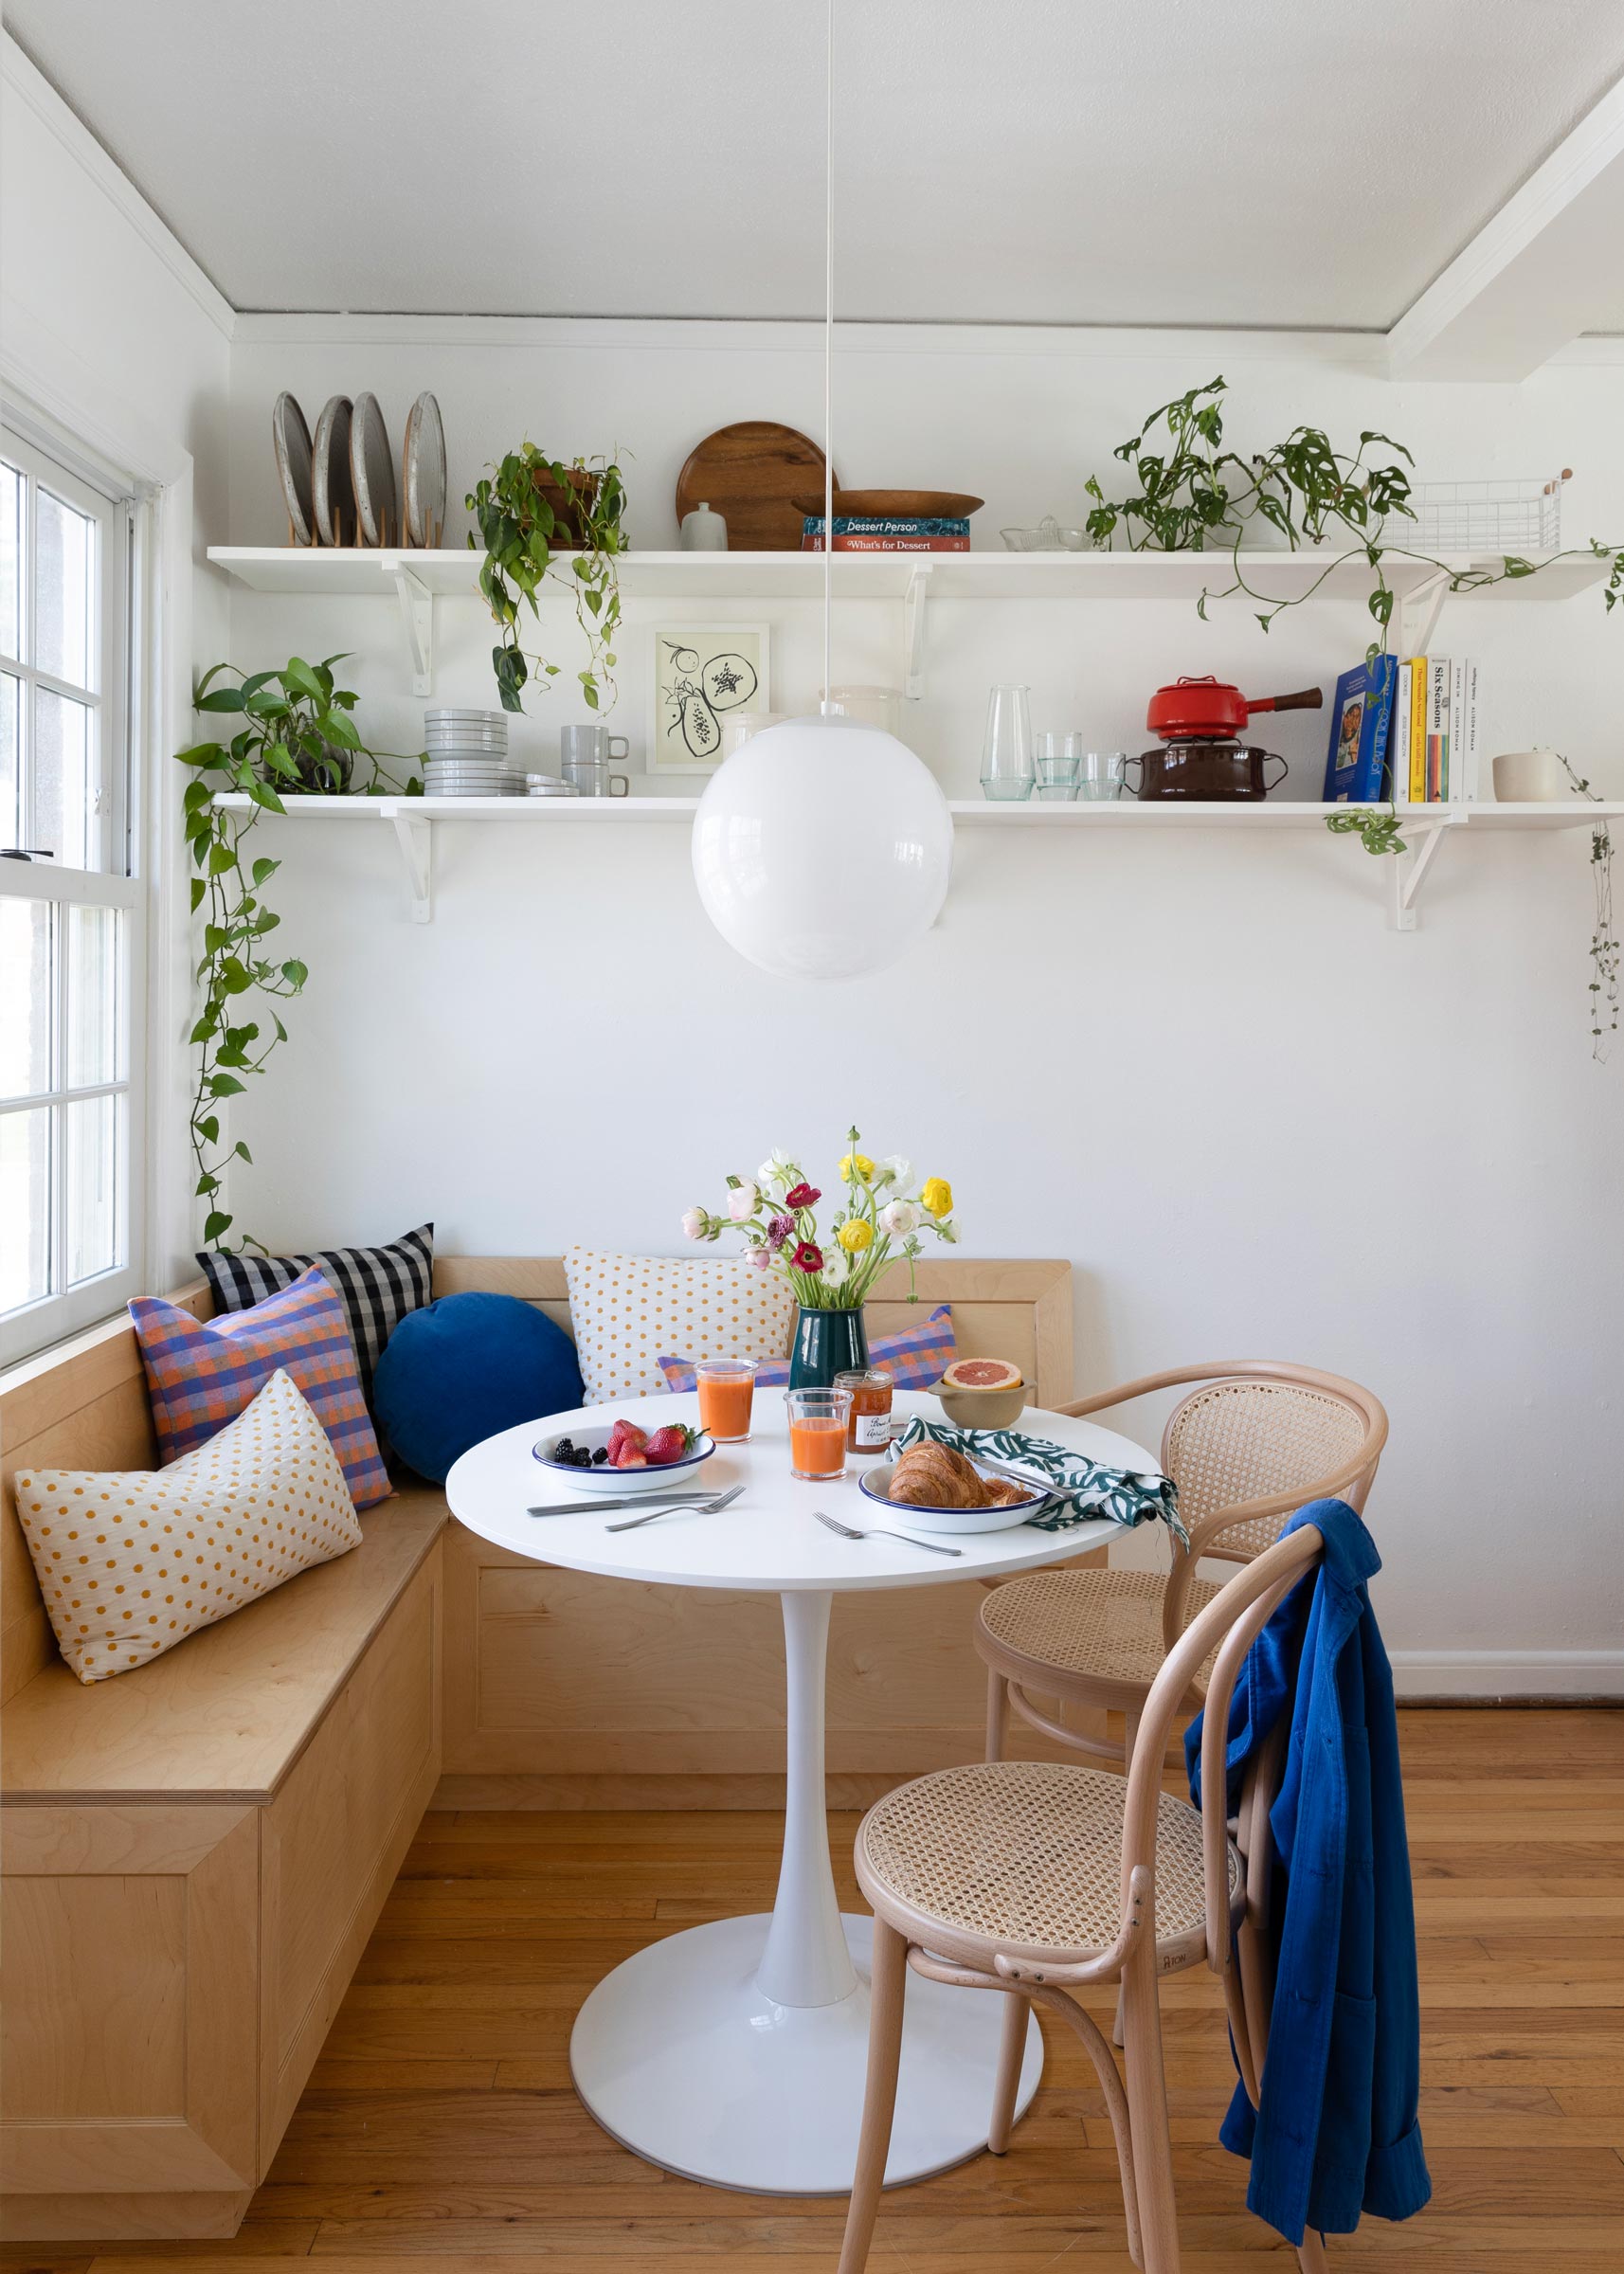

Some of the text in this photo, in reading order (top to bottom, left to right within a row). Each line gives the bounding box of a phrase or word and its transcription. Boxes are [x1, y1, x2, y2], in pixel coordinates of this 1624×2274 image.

[846, 521, 917, 532] Dessert Person
[846, 540, 931, 550] What's for Dessert
[1435, 666, 1444, 684] Six
[1434, 685, 1443, 729] Seasons
[1378, 708, 1389, 731] COOK
